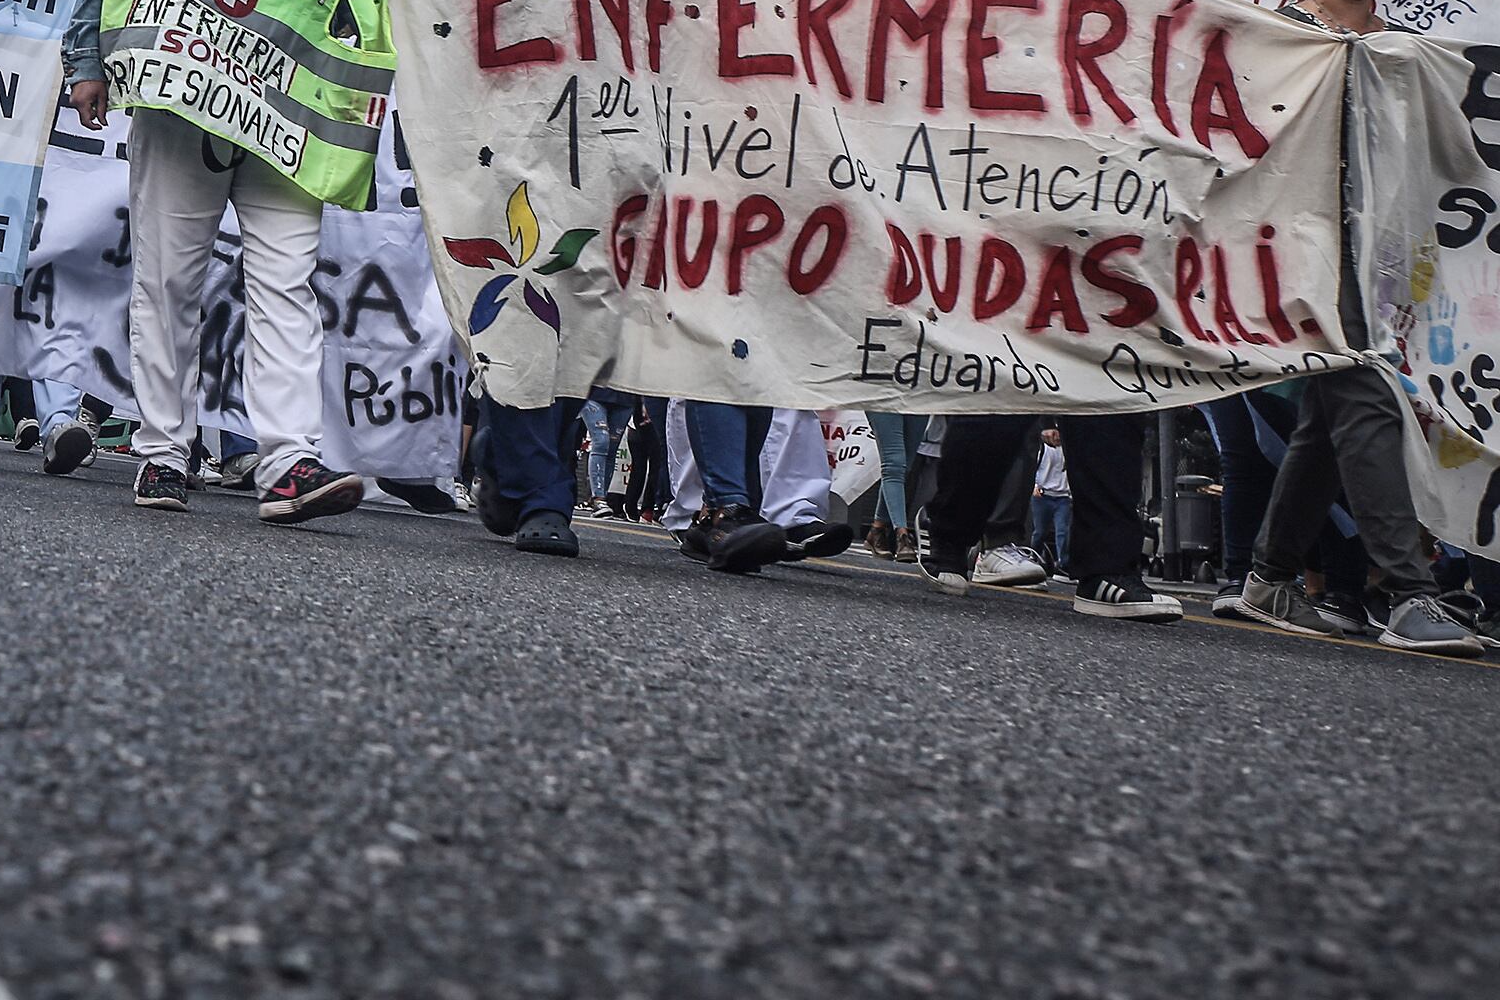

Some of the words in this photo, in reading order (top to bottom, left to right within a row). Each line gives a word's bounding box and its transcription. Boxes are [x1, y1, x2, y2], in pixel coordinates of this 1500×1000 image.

[160, 28, 263, 98] SOMOS
[895, 121, 1176, 226] Atención
[856, 316, 1062, 396] Eduardo
